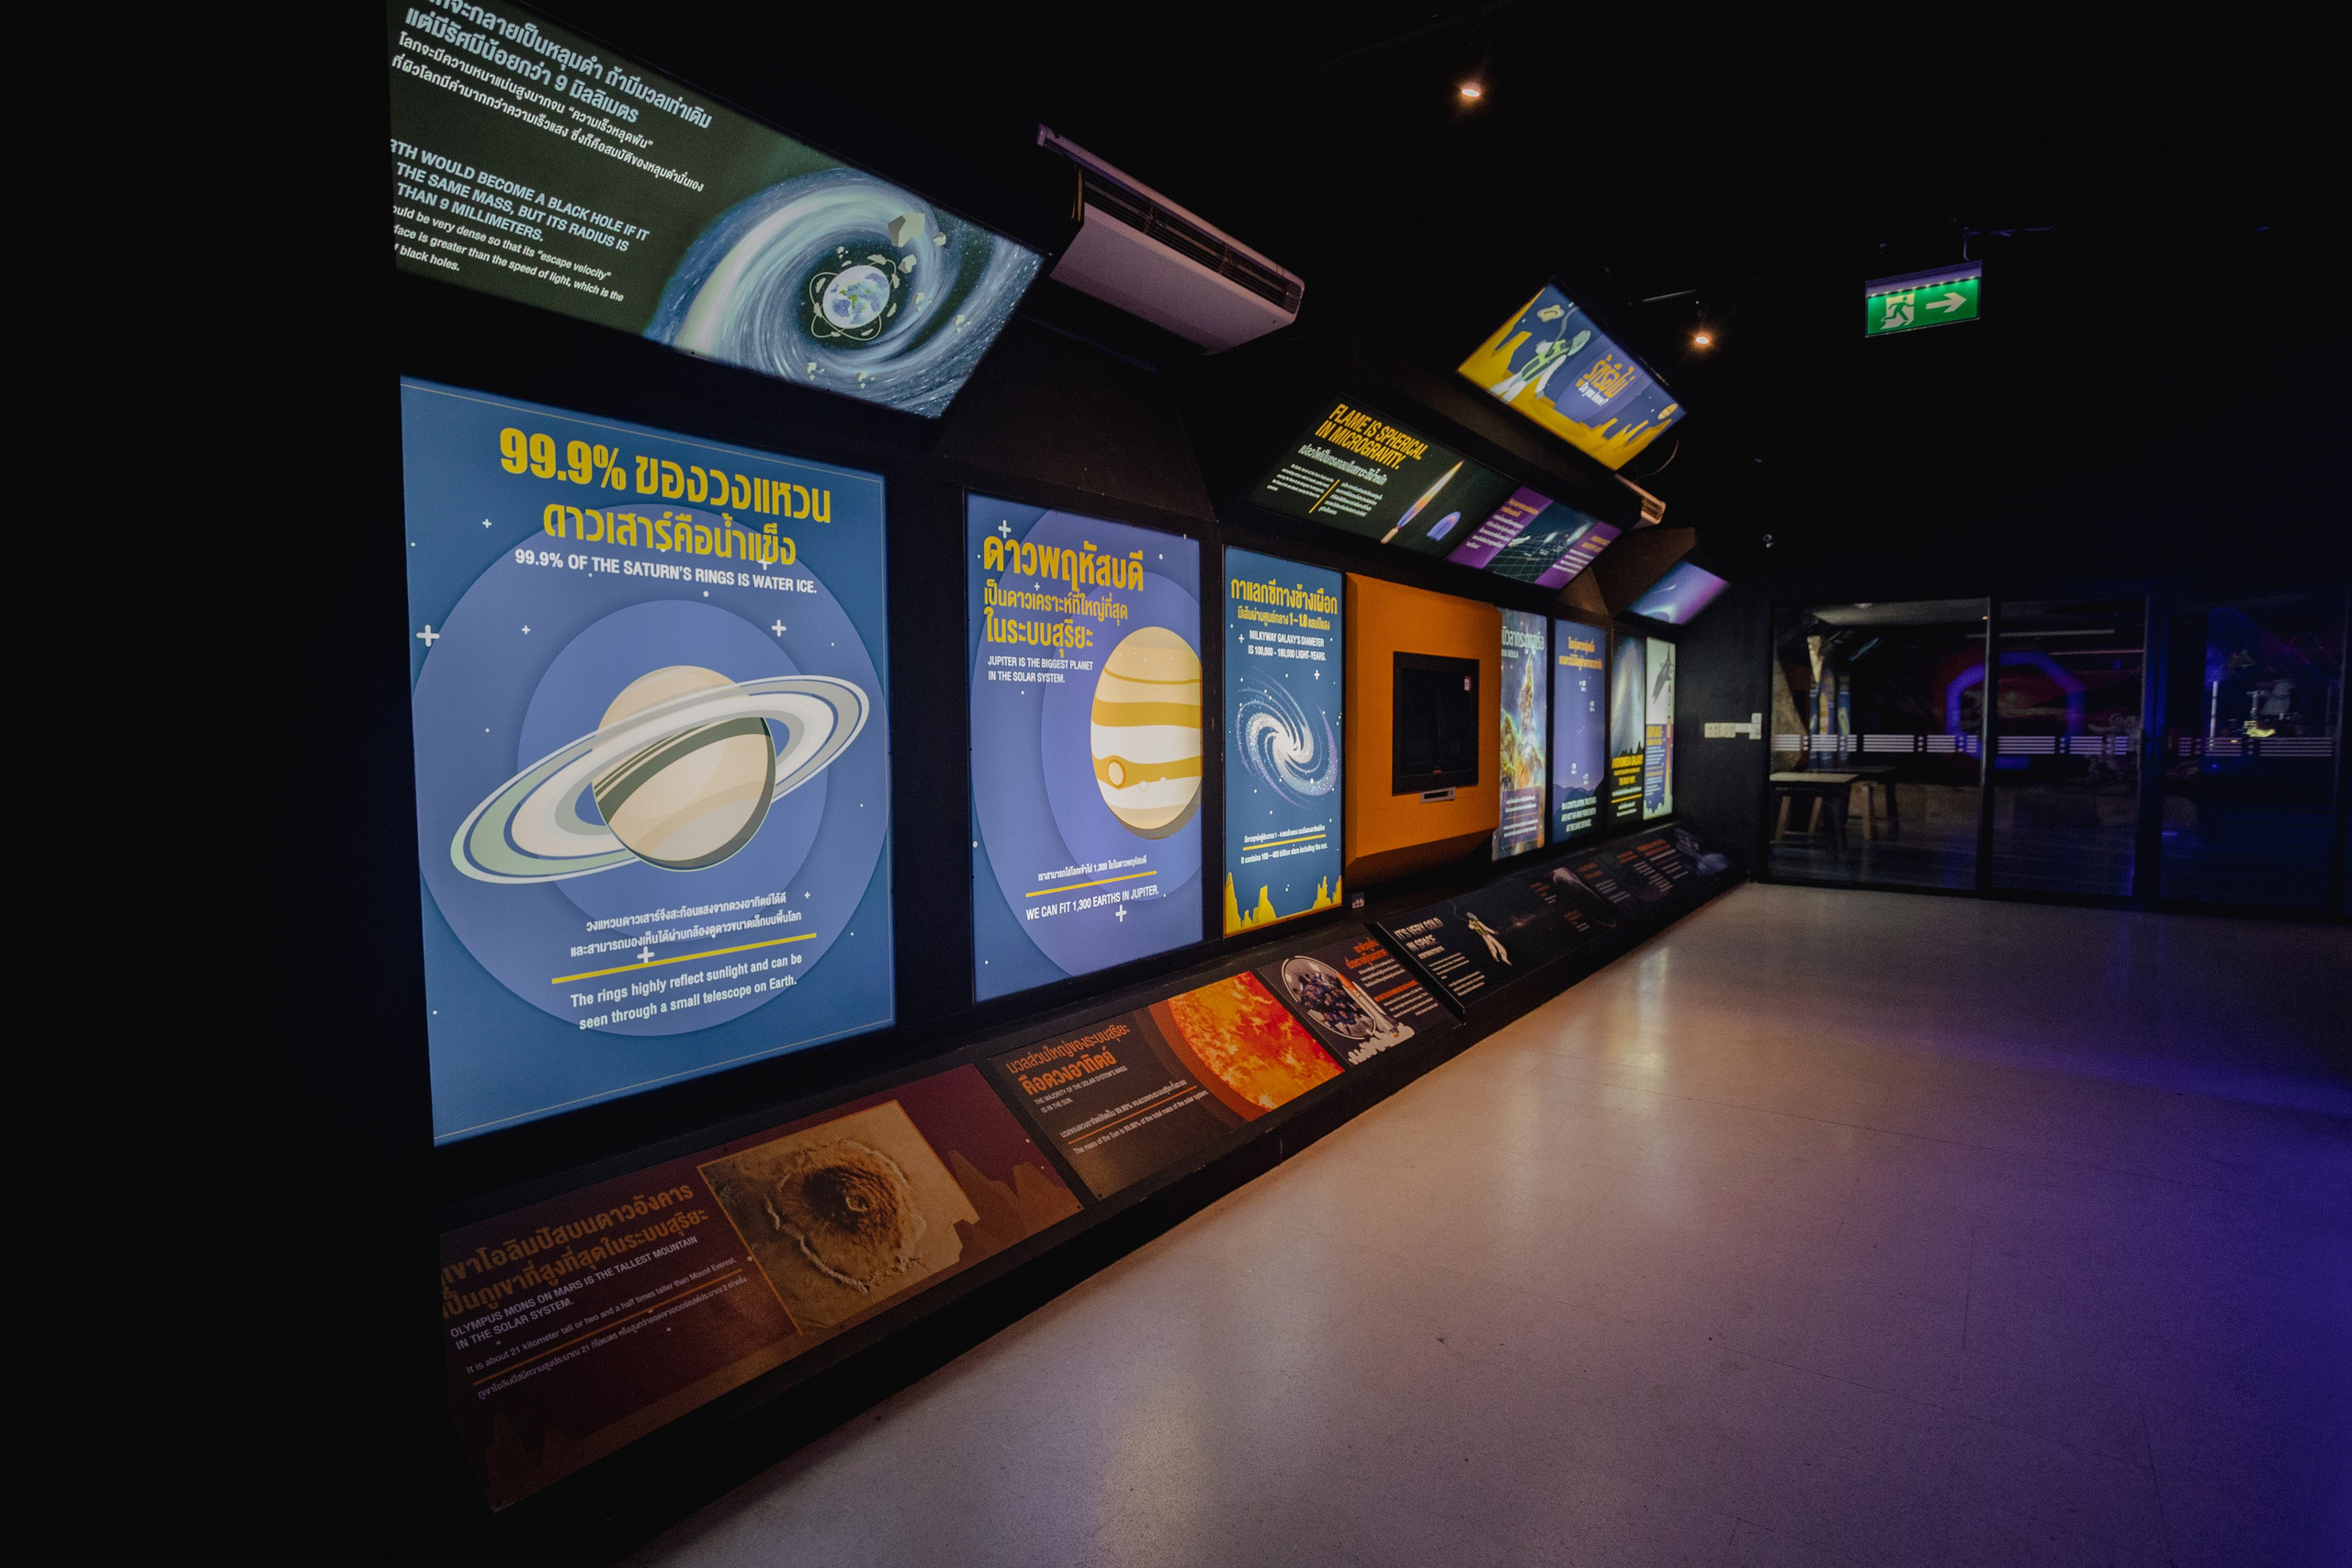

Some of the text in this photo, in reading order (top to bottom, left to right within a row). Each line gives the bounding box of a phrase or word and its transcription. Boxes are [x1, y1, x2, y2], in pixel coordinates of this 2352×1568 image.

[397, 162, 628, 251] THE SAME MASS, BUT ITS RADIUS IS
[397, 182, 543, 242] THAN 9 MILLIMETERS.
[421, 150, 475, 179] WOULD
[476, 171, 535, 201] BECOME
[534, 193, 544, 205] A
[547, 196, 590, 220] BLACK
[589, 211, 623, 231] HOLE
[623, 223, 637, 235] IF
[635, 228, 650, 241] IT
[399, 244, 459, 271] black holes.
[415, 211, 430, 223] be
[432, 218, 456, 232] very
[456, 225, 486, 242] dense
[487, 236, 501, 245] so
[502, 239, 522, 253] that
[522, 245, 535, 256] its
[417, 231, 428, 243] is
[429, 237, 468, 254] greater
[468, 247, 490, 261] than
[492, 254, 507, 266] the
[507, 261, 537, 276] speed
[537, 269, 549, 278] of
[548, 271, 571, 287] light,
[573, 280, 599, 294] which
[599, 287, 609, 297] is
[609, 290, 624, 301] the
[1315, 420, 1406, 470] IN MICROGRAVITY.
[1329, 403, 1428, 460] FLAME IS SPHERICAL
[500, 427, 831, 523] 99.9% ของวงแหวน
[514, 548, 563, 568] 99.9%
[568, 554, 587, 570] OF
[591, 556, 619, 573] THE
[695, 568, 734, 585] RINGS
[737, 572, 750, 586] IS
[752, 574, 793, 591] WATER
[796, 579, 817, 593] ICE.
[983, 536, 1143, 592] ดาวพฤหัสบดี
[984, 607, 1093, 658] ในระบบสุริยะ
[987, 655, 1093, 670] JUPITER IS THE BIGGEST PLANET
[988, 671, 1065, 682] IN THE SOLAR SYSTEM.
[1093, 862, 1107, 872] 1,300
[1025, 885, 1159, 919] WE CAN FIT 1,300 EARTHS IN JUPITER.
[570, 953, 801, 1007] The rings highly reflect sunlight and can be
[579, 974, 797, 1030] seen through a small telescope on Earth.
[450, 1235, 697, 1337] OLYMPUS MONS ON MARS IS THE TALLEST MOUNTAIN
[485, 1350, 509, 1366] about
[509, 1346, 520, 1356] 21
[521, 1330, 559, 1349] kilometer
[560, 1323, 573, 1334] tall
[574, 1320, 582, 1328] or
[583, 1314, 599, 1324] two
[599, 1306, 614, 1317] and
[619, 1297, 635, 1309] half
[634, 1291, 656, 1303] times
[654, 1282, 673, 1294] taller
[673, 1277, 689, 1286] than
[688, 1267, 711, 1280] Mount
[710, 1257, 736, 1271] Everest.
[455, 1297, 573, 1349] IN THE SOLAR SYSTEM.
